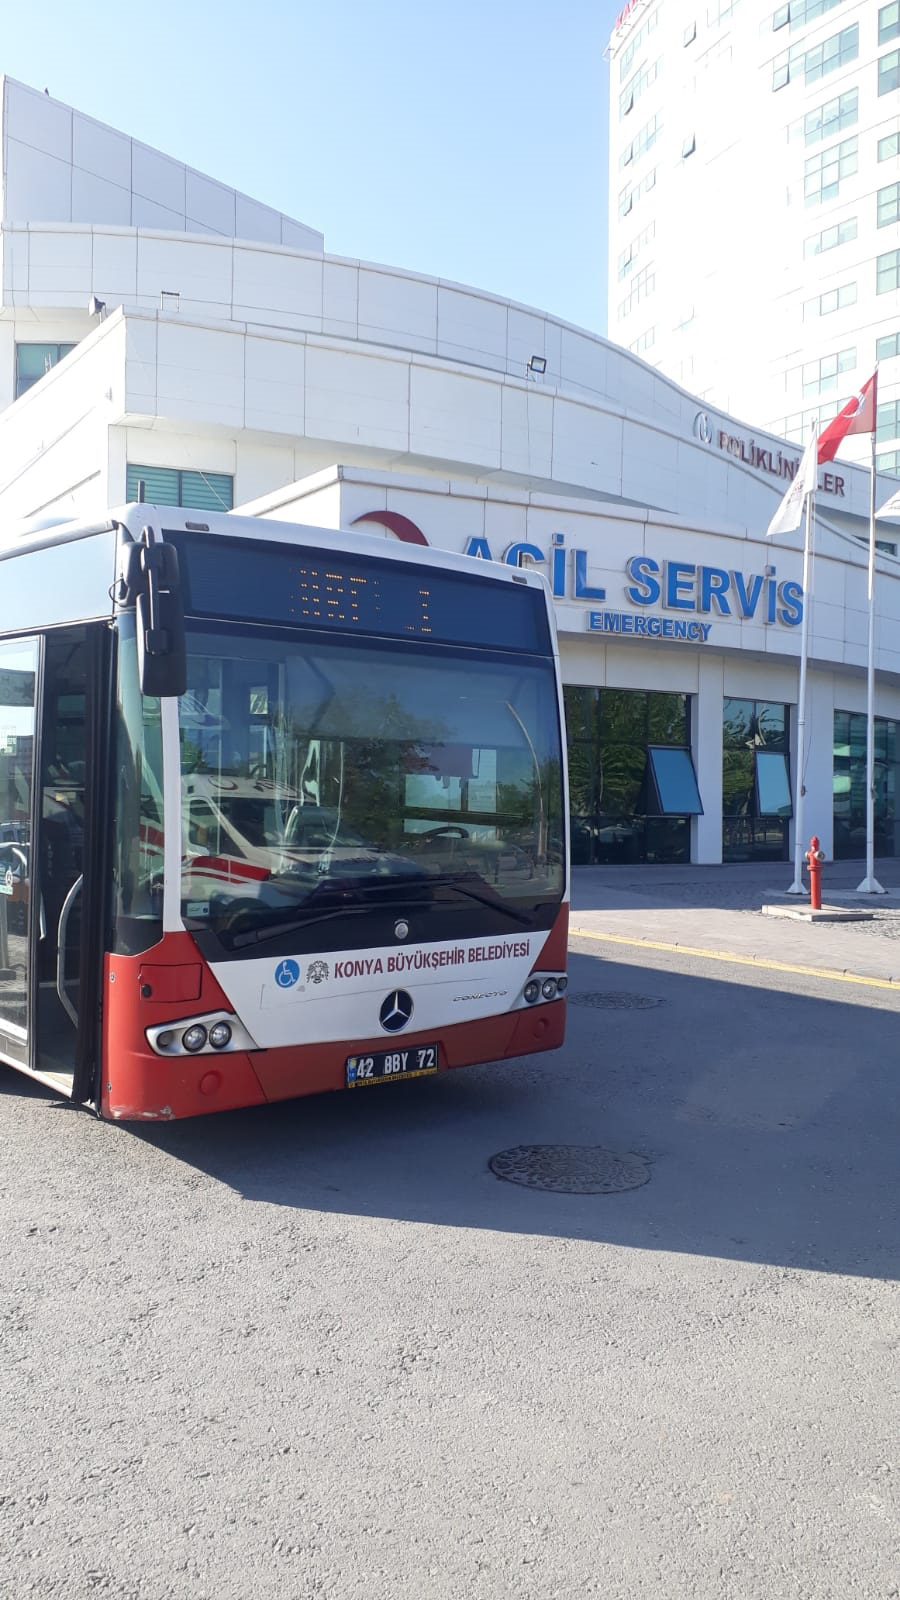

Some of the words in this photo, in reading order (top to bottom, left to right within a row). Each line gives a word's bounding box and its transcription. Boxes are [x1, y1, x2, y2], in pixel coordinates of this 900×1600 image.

[717, 429, 846, 498] POLİKLİNİER
[624, 555, 805, 628] SERVİS
[587, 610, 713, 643] EMERGENCY
[334, 958, 384, 979] KONYA
[387, 946, 465, 972] BÜYÜKŞEHİR
[467, 938, 530, 963] BELEDİYESİ
[357, 1057, 375, 1078] 42
[384, 1052, 409, 1074] BBY
[418, 1048, 435, 1069] 72
